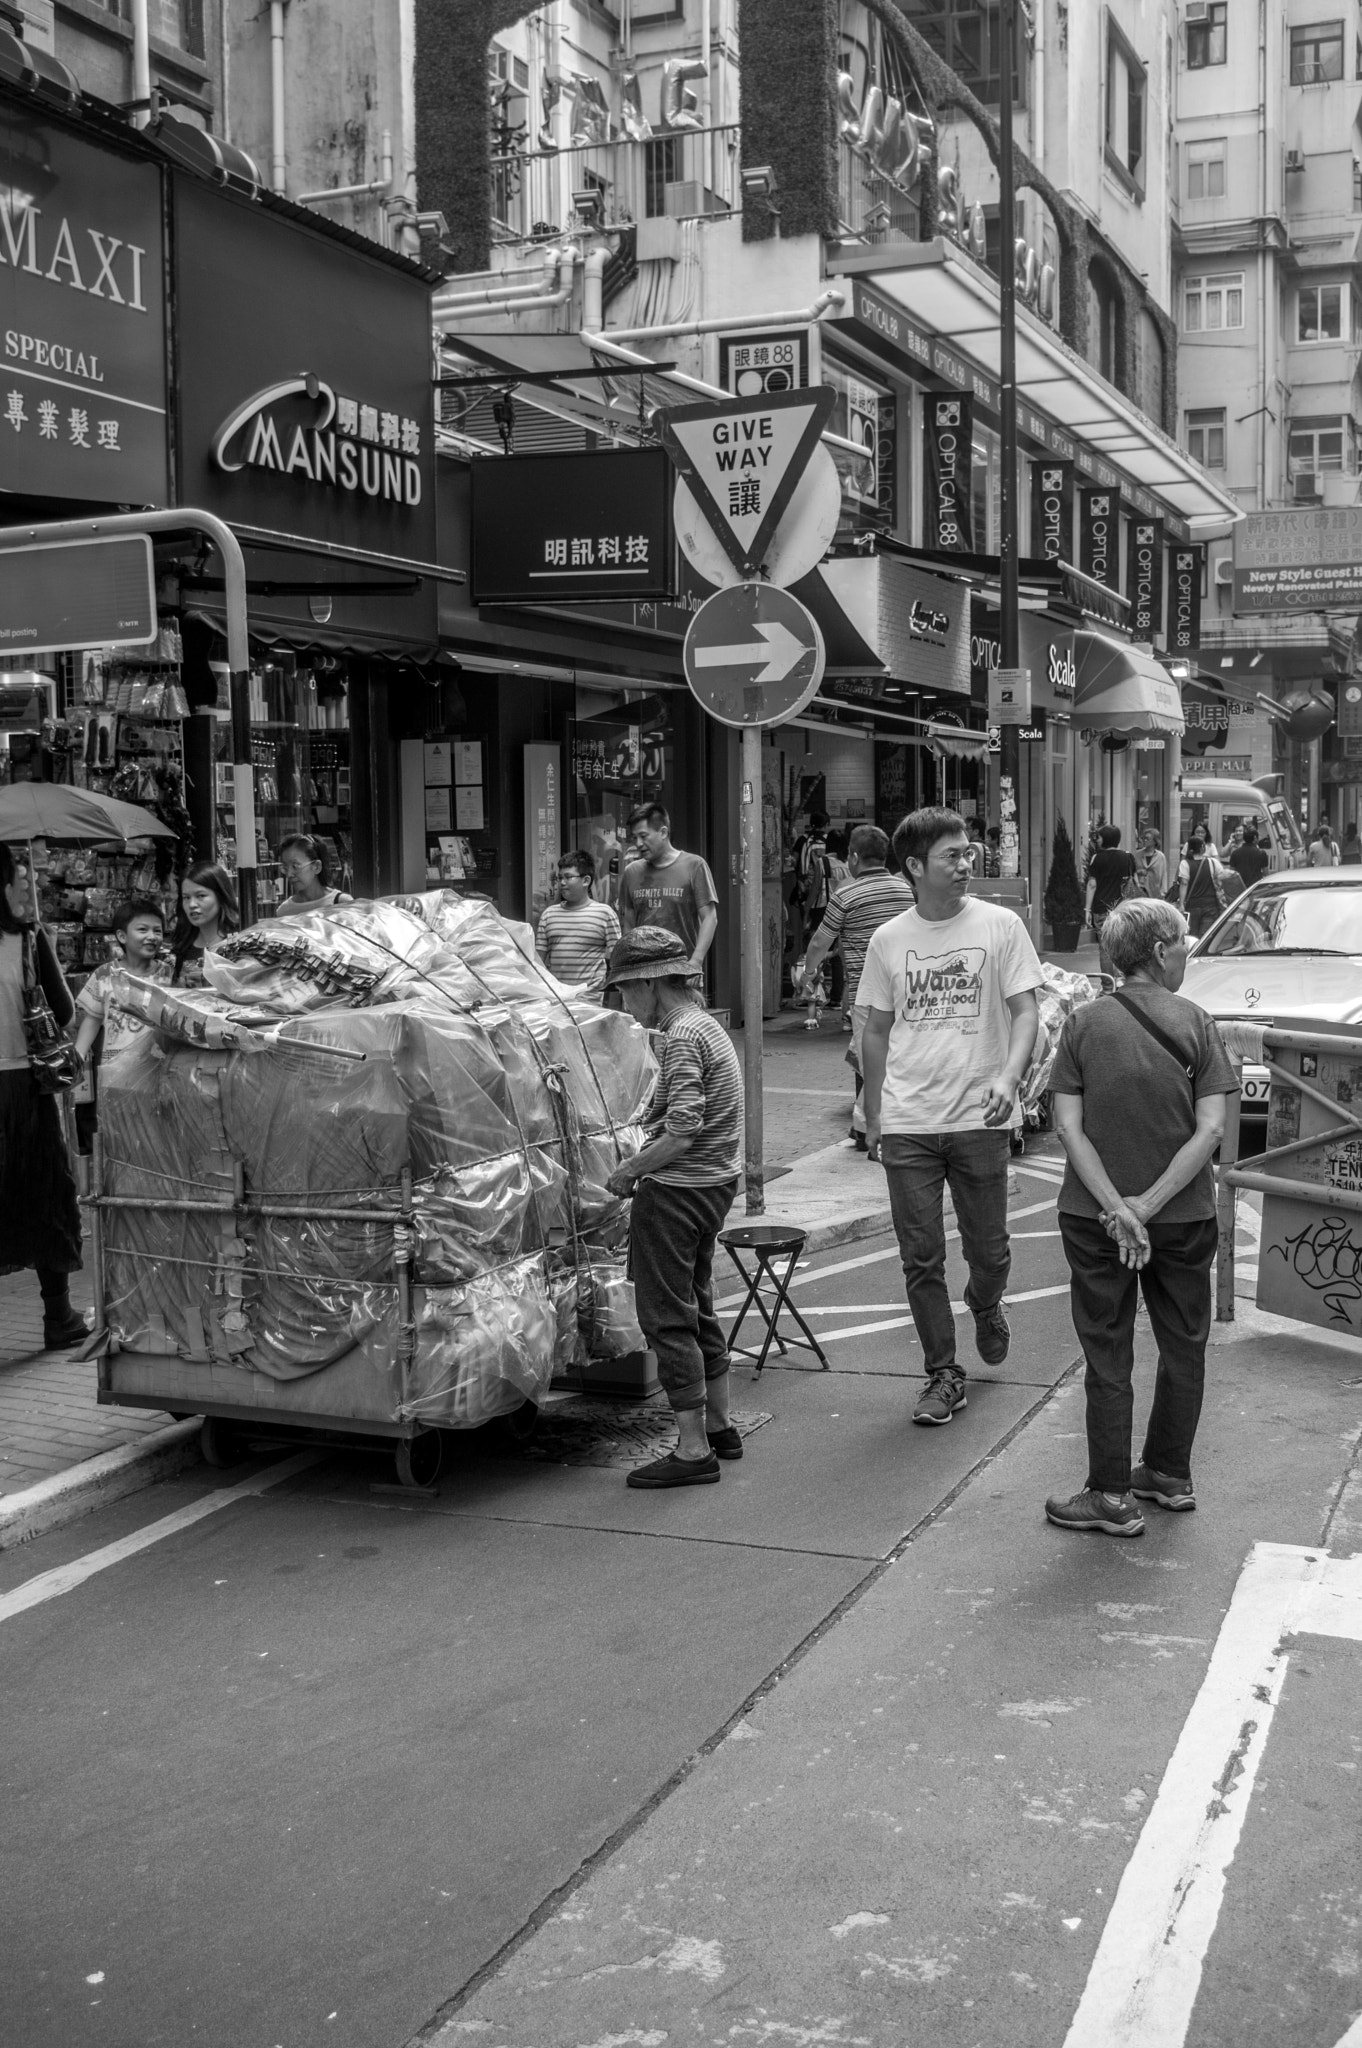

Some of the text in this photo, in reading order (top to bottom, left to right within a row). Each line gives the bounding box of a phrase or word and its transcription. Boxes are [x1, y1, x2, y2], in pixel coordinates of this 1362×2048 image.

[0, 203, 147, 312] MAXI
[861, 297, 898, 340] OPTICAL 88
[5, 330, 104, 382] SPECIAL
[735, 344, 794, 367] 眼鏡88
[934, 349, 959, 383] OPTICAL
[3, 389, 122, 452] 專業髮理
[337, 396, 421, 457] 明訊科技
[712, 416, 774, 445] GIVE
[248, 413, 421, 506] MANSUND
[716, 445, 773, 473] WAY
[728, 479, 761, 517] 讓
[939, 433, 957, 546] OPTICAL 88
[544, 535, 650, 566] 明訊科技
[1137, 549, 1152, 610] OPTICAL
[1242, 584, 1275, 594] Newly
[1277, 581, 1333, 592] Renovated
[1249, 572, 1278, 583] New
[1279, 568, 1312, 583] Style
[1314, 566, 1351, 579] Guest
[1137, 611, 1151, 628] 88
[1177, 574, 1191, 647] OPTICAL 88
[12, 628, 38, 639] posting
[1049, 644, 1076, 687] Scala
[1019, 728, 1042, 739] Scala
[633, 887, 684, 898] YOSEMITE VALLEY
[906, 968, 980, 994] Waves
[920, 993, 938, 1008] the
[942, 990, 977, 1006] Hood
[925, 1006, 957, 1017] MOTEL
[1240, 1080, 1270, 1098] 07
